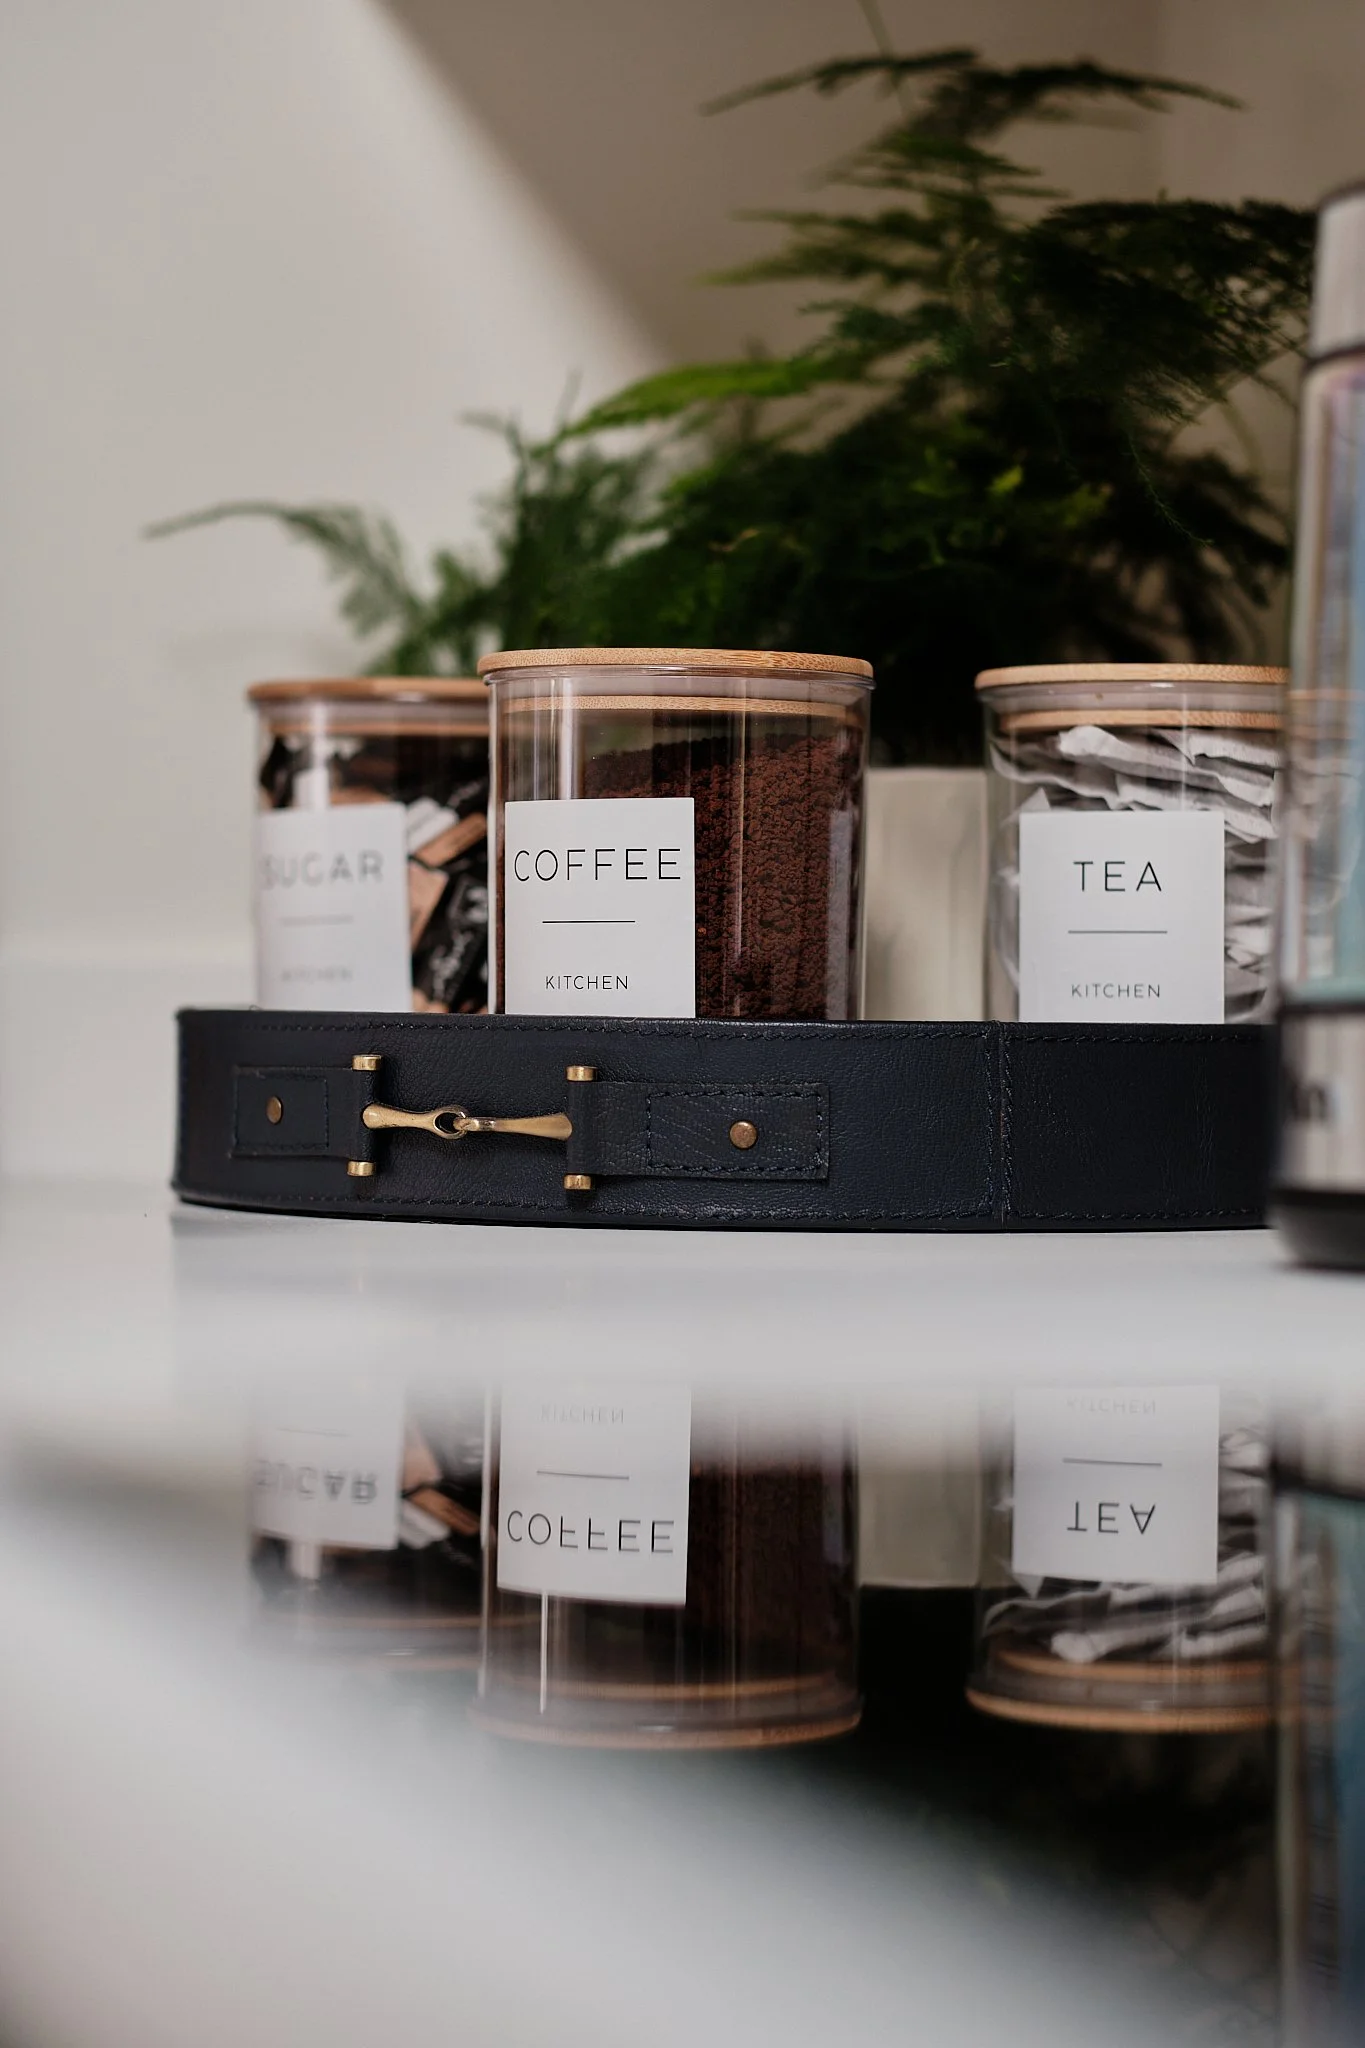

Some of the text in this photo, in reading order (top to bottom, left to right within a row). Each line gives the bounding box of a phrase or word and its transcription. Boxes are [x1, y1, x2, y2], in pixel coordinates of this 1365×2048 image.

[513, 848, 682, 883] COFFEE
[1073, 860, 1163, 892] TEA
[545, 974, 630, 991] KITCHEN
[1071, 983, 1161, 998] KITCHEN
